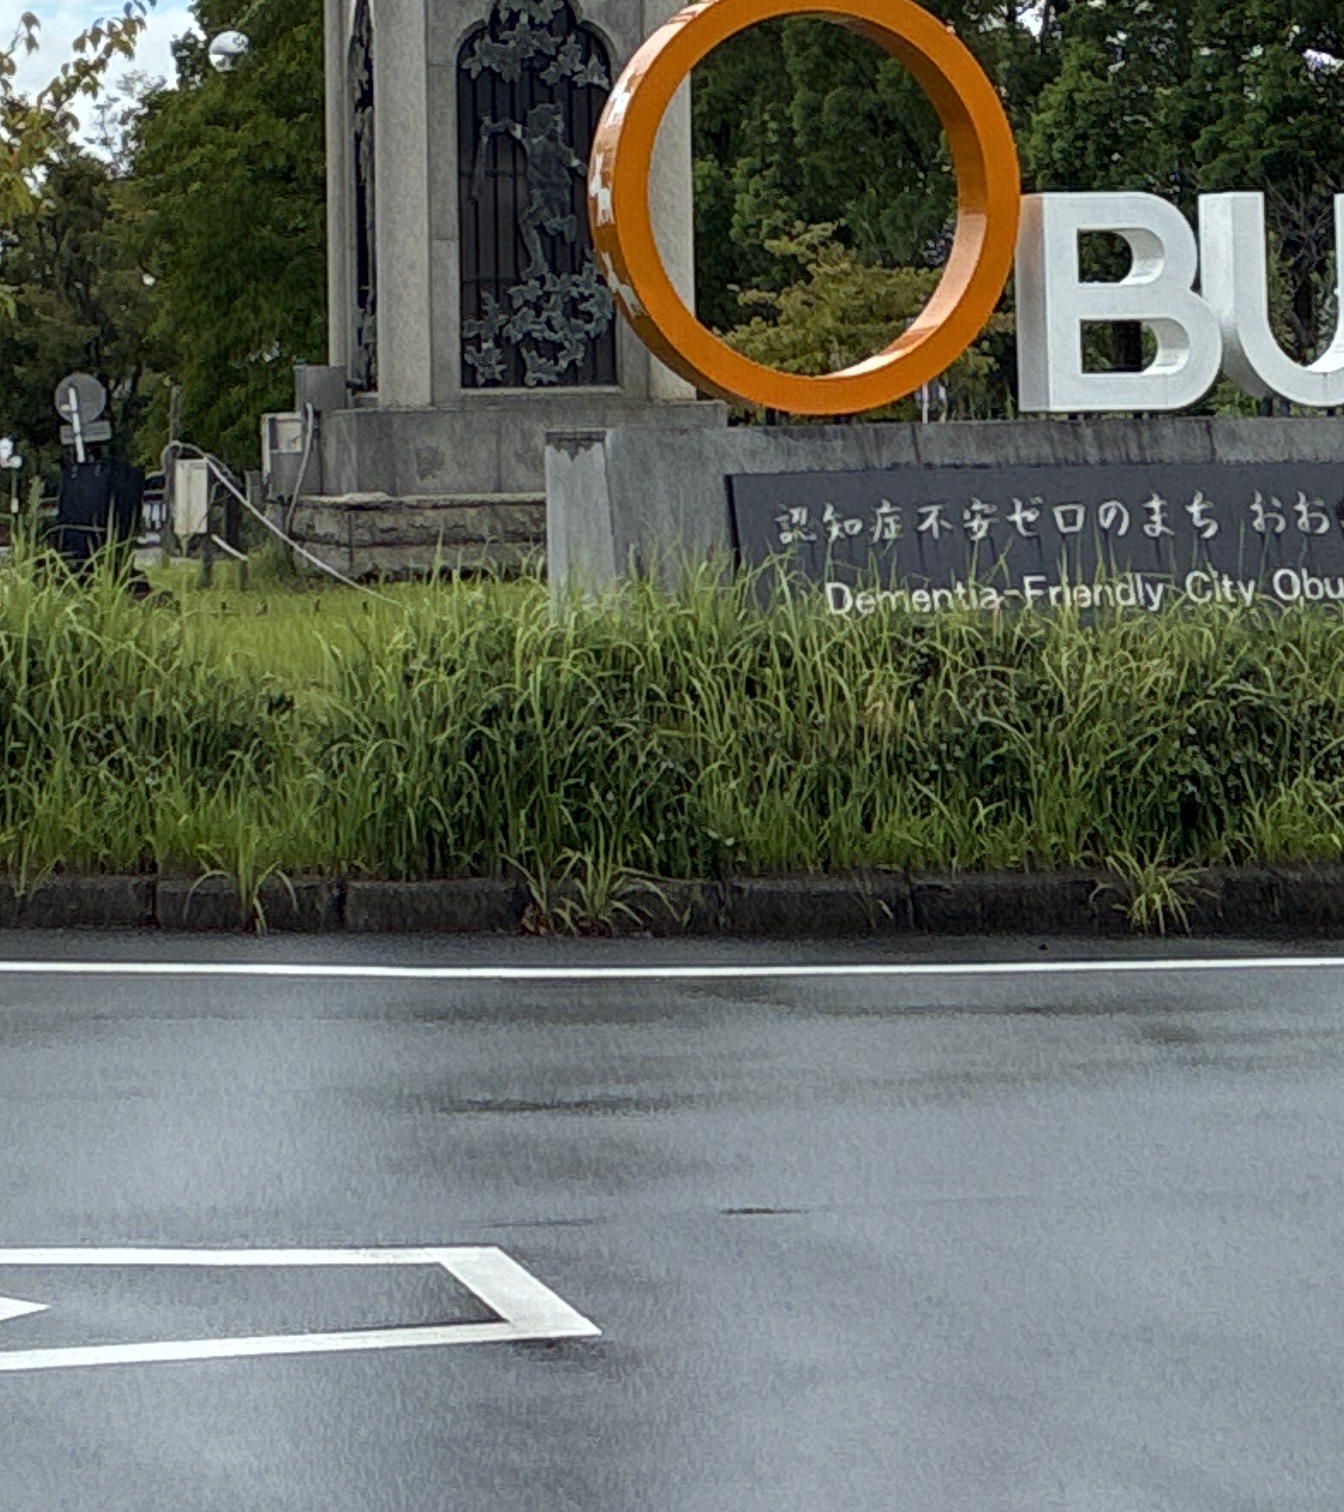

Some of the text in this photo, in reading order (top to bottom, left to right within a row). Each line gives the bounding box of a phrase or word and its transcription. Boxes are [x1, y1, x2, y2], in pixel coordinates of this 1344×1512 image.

[774, 488, 1219, 545] 認知症不安ゼロのまち
[826, 572, 1164, 615] Dementia-Friendly
[1185, 570, 1255, 607] City
